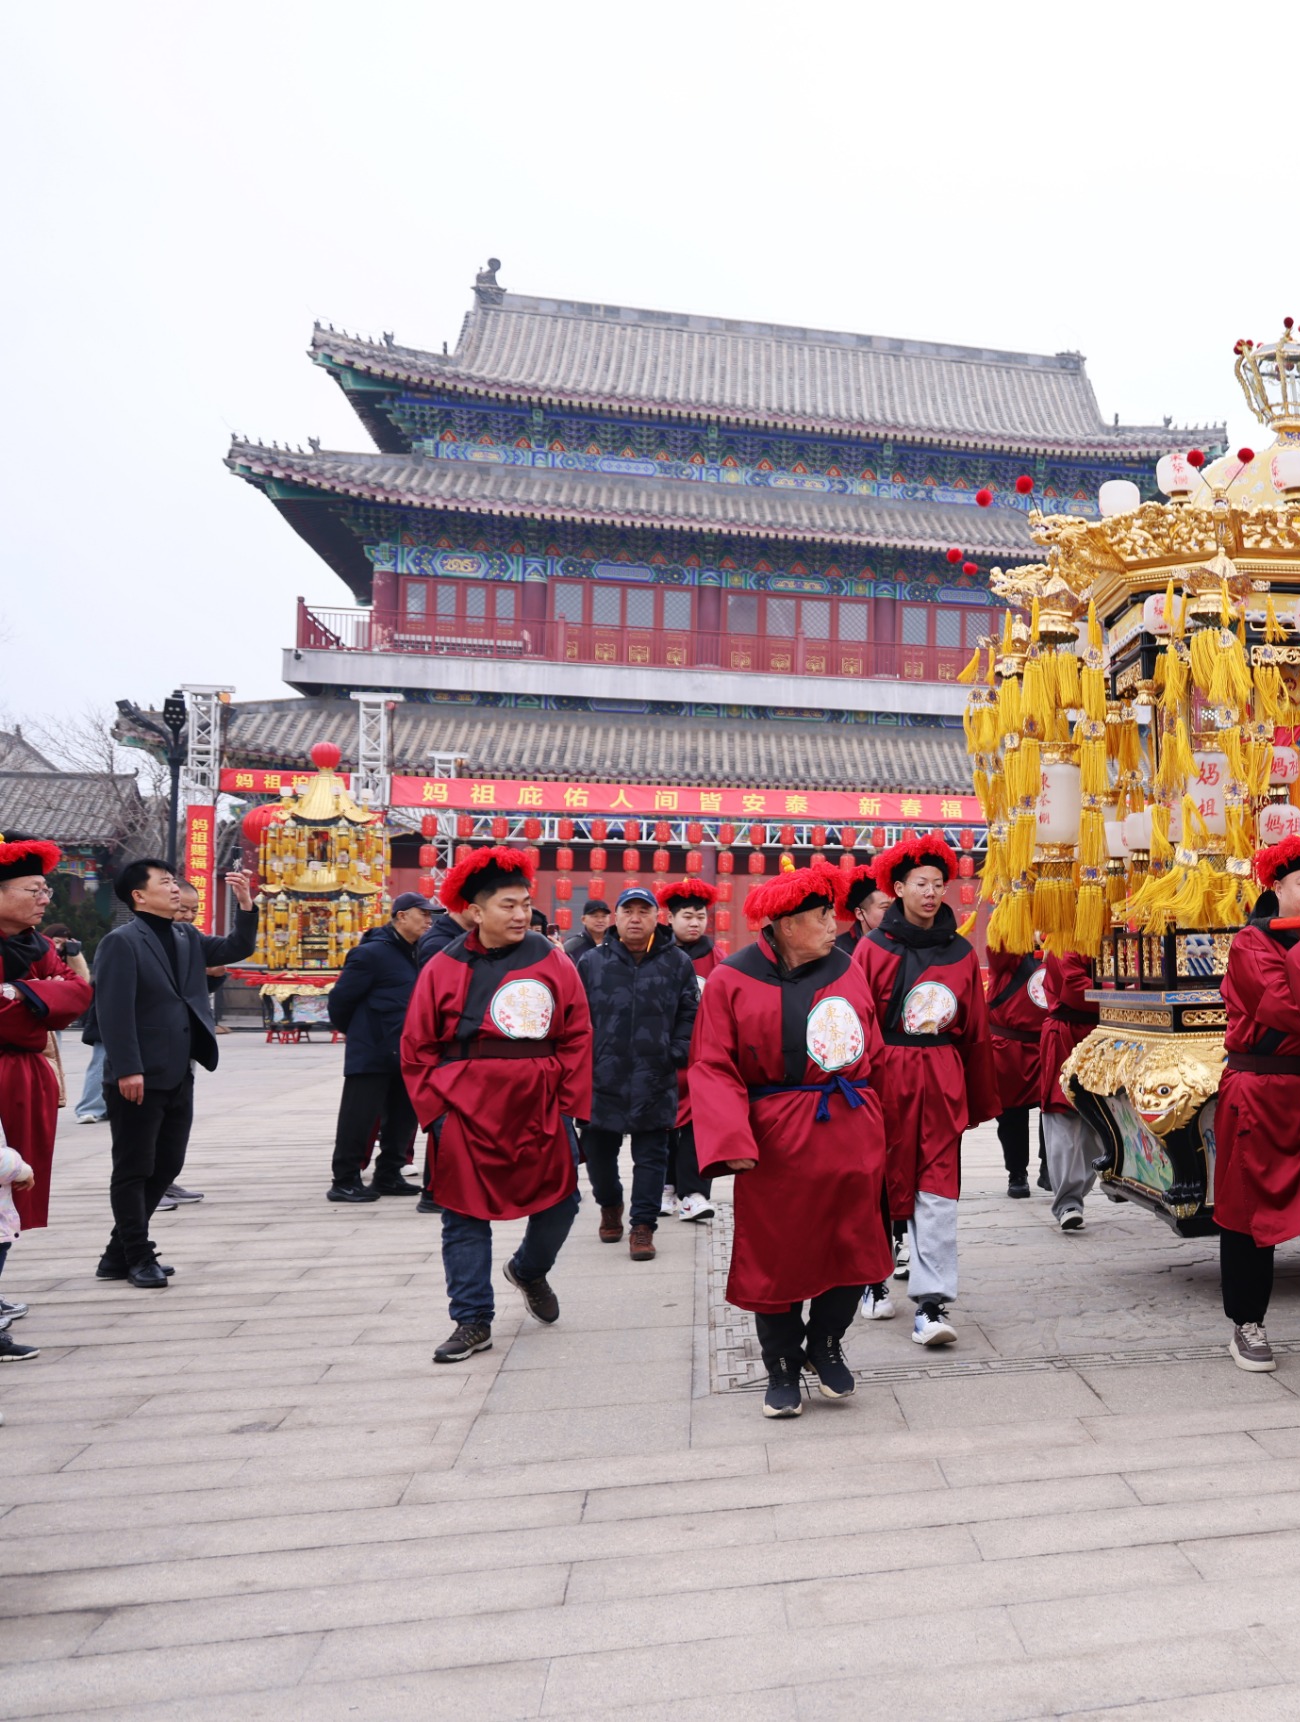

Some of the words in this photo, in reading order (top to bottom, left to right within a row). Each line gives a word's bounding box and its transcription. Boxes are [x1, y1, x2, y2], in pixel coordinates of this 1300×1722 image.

[1271, 754, 1299, 778] 妈祖
[422, 782, 808, 814] 妈祖庇佑人间皆安泰
[859, 797, 987, 819] 新春福
[1196, 761, 1220, 817] 妈祖
[1265, 812, 1300, 835] 妈祖
[190, 818, 208, 869] 妈祖赐福
